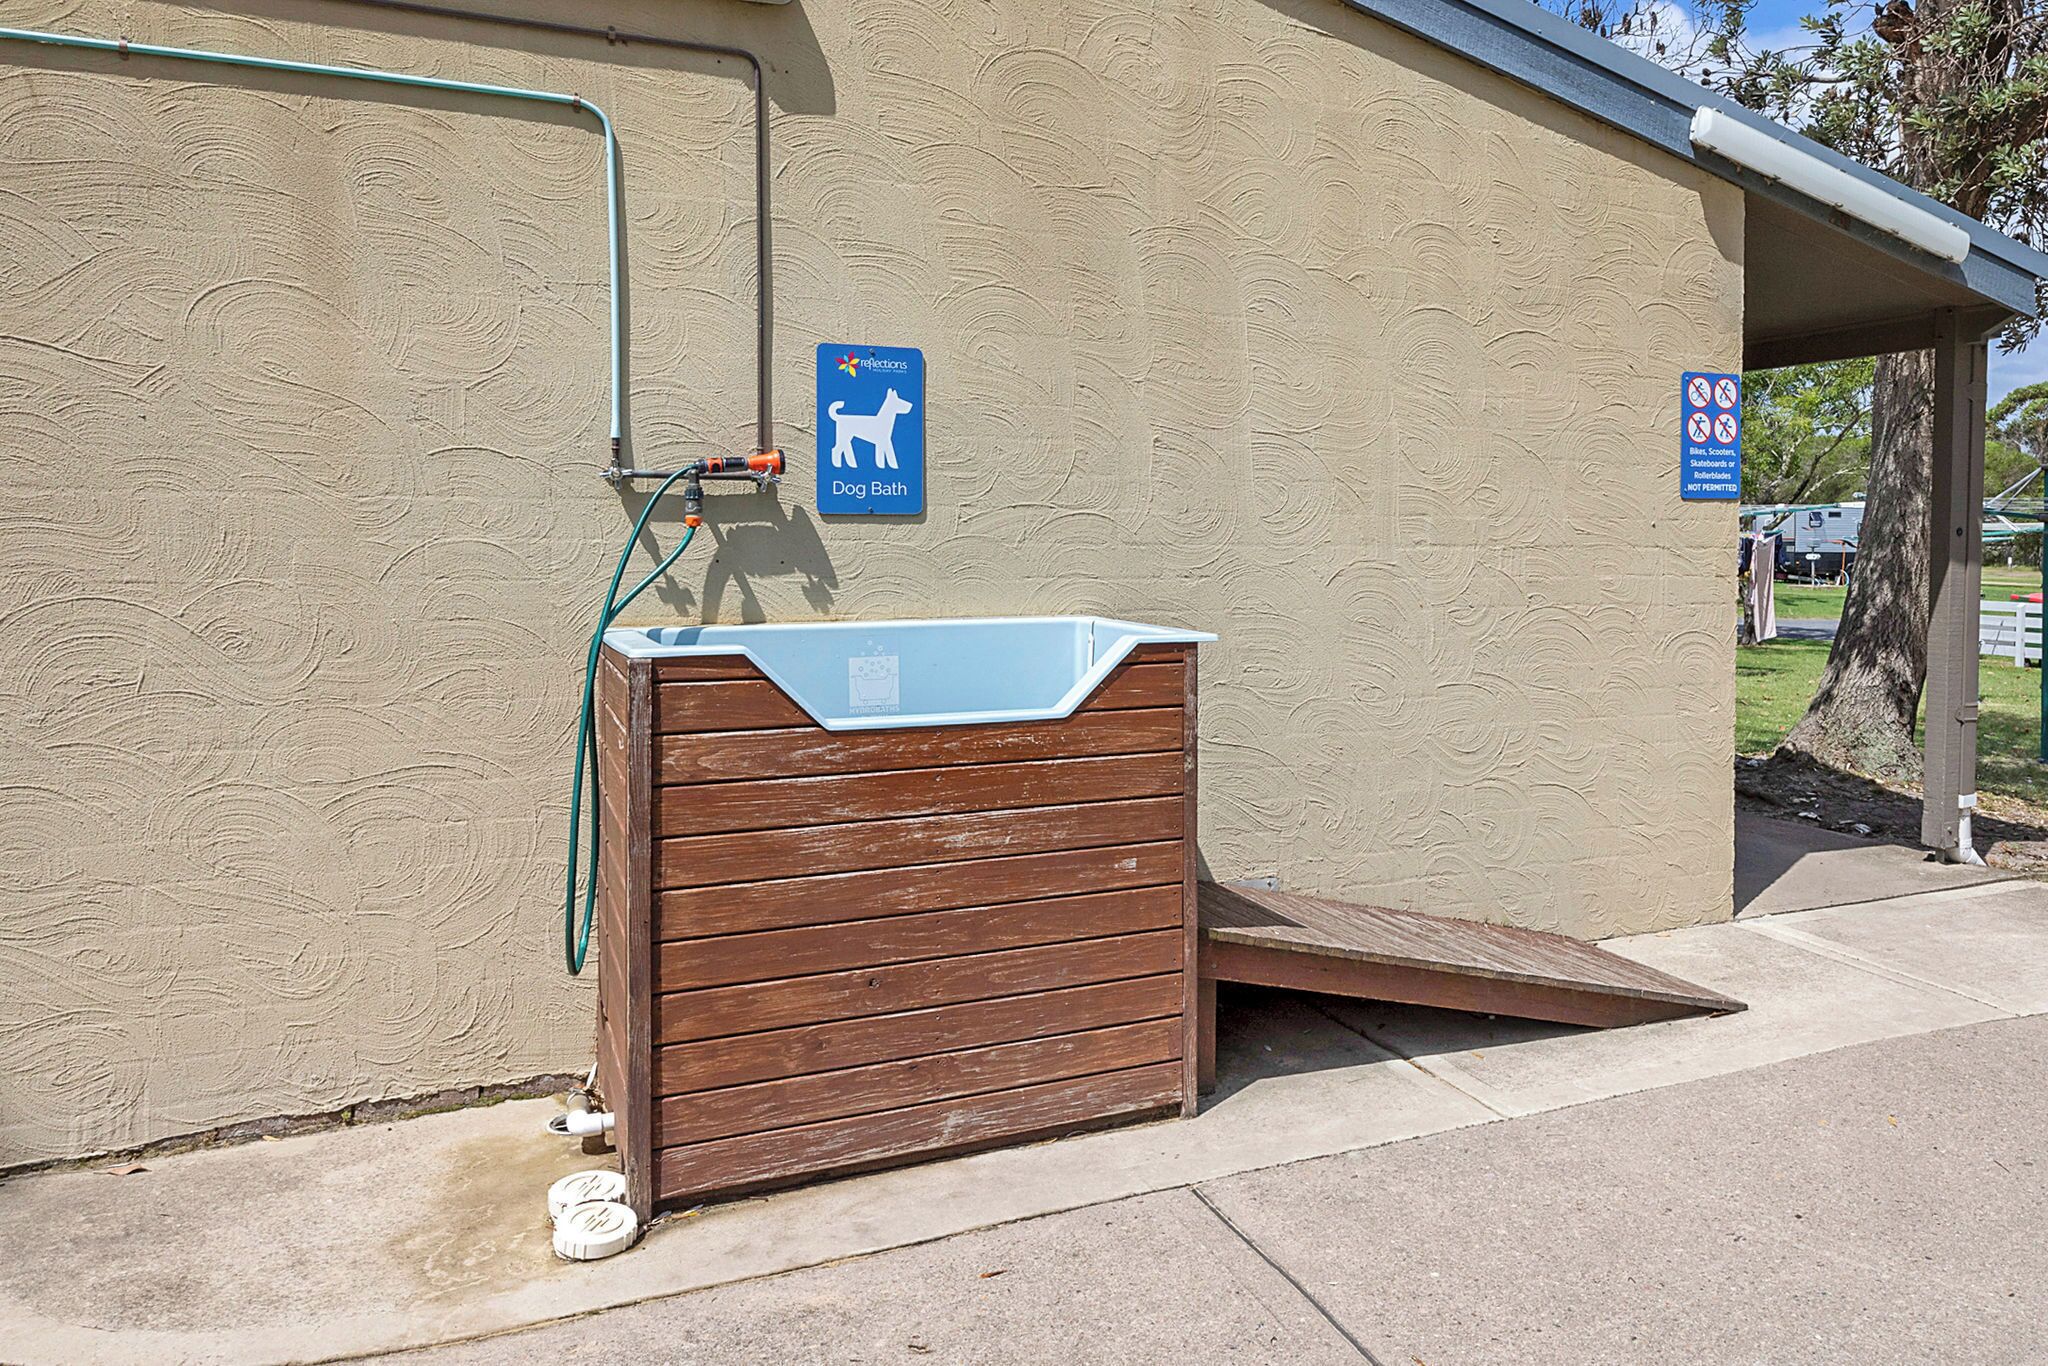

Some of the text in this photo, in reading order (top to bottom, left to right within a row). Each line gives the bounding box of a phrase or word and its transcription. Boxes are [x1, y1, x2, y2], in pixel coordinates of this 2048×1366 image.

[860, 357, 907, 370] reflections
[1689, 447, 1736, 456] Bikes, Scooters,
[1690, 459, 1727, 468] Skateboards
[1694, 471, 1731, 480] Rollerblades
[833, 480, 907, 499] Dog Bath
[1687, 483, 1737, 492] NOT PERMITTED
